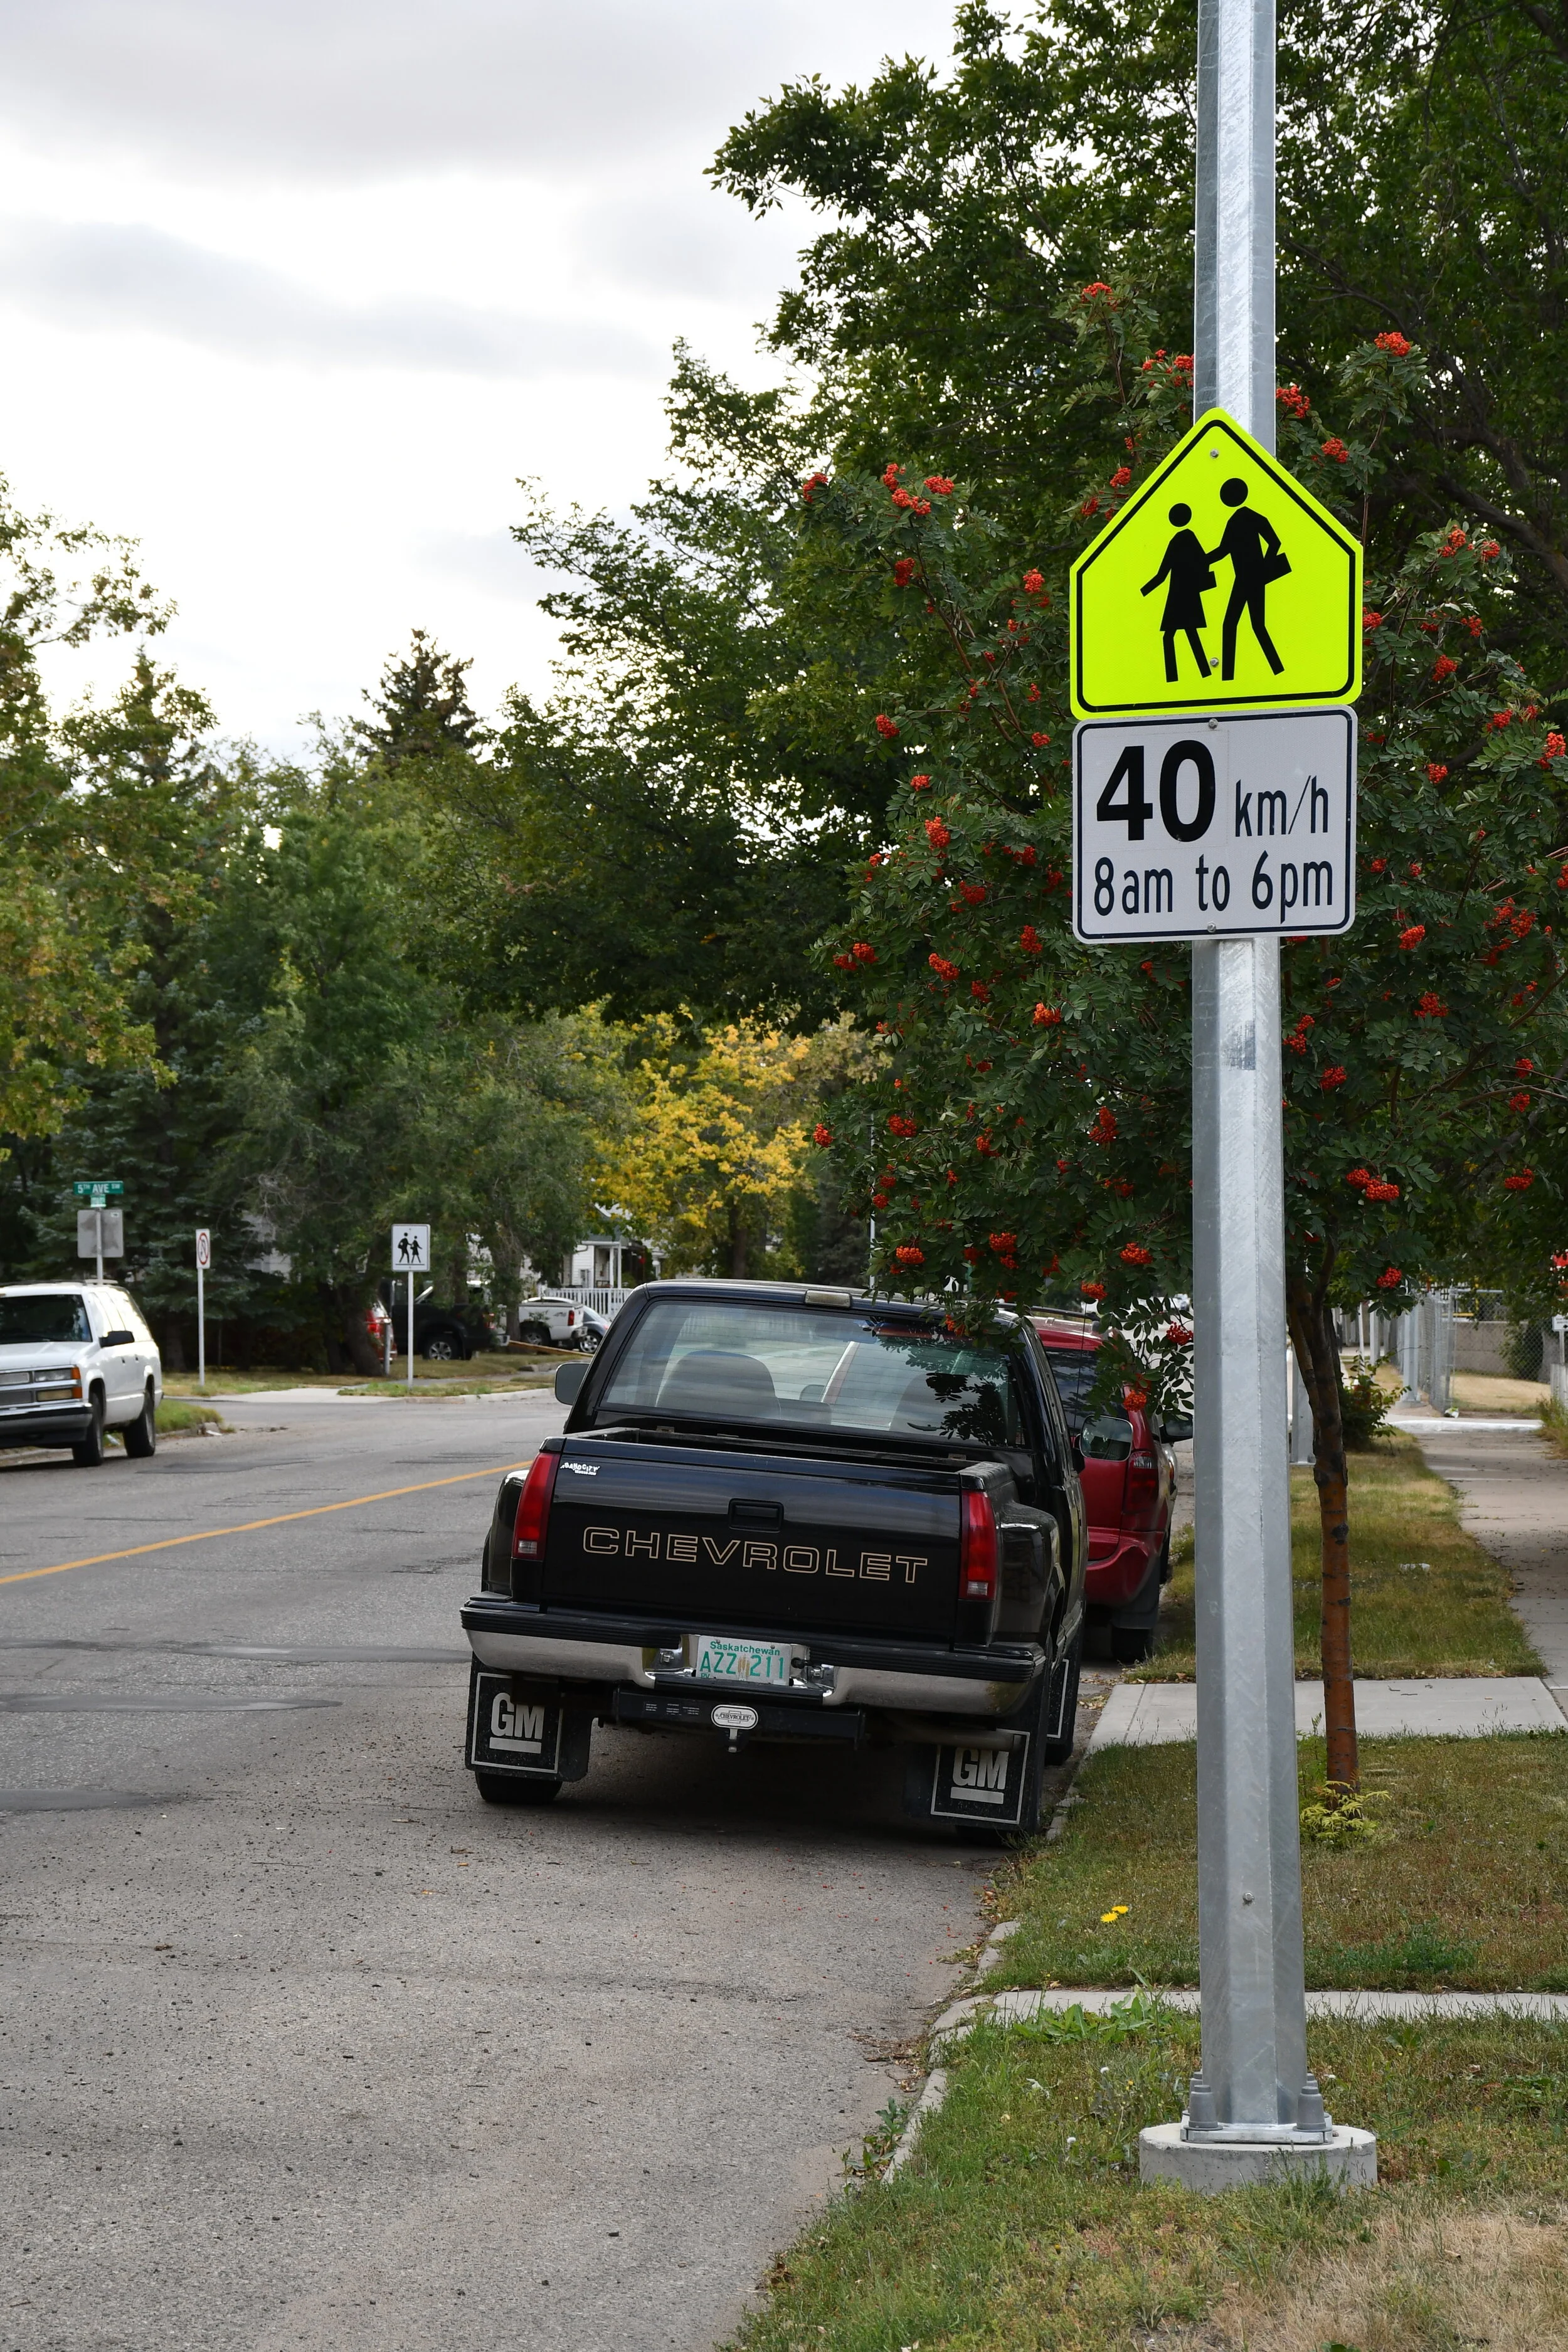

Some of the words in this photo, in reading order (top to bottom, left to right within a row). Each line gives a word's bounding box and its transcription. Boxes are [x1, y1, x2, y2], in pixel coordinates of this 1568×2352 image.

[1096, 739, 1216, 842] 40
[1235, 775, 1328, 837] km/h
[1094, 857, 1173, 916] 8am
[1195, 854, 1230, 911] to
[1252, 850, 1333, 924] 6pm
[92, 1184, 110, 1193] AVE
[564, 1462, 582, 1470] BAND
[583, 1526, 928, 1584] CHEVROLET
[699, 1651, 737, 1675] AZZ
[750, 1655, 784, 1679] 211
[710, 1641, 780, 1656] Saskatchewan
[491, 1693, 544, 1739] GM
[953, 1747, 1009, 1789] GM
